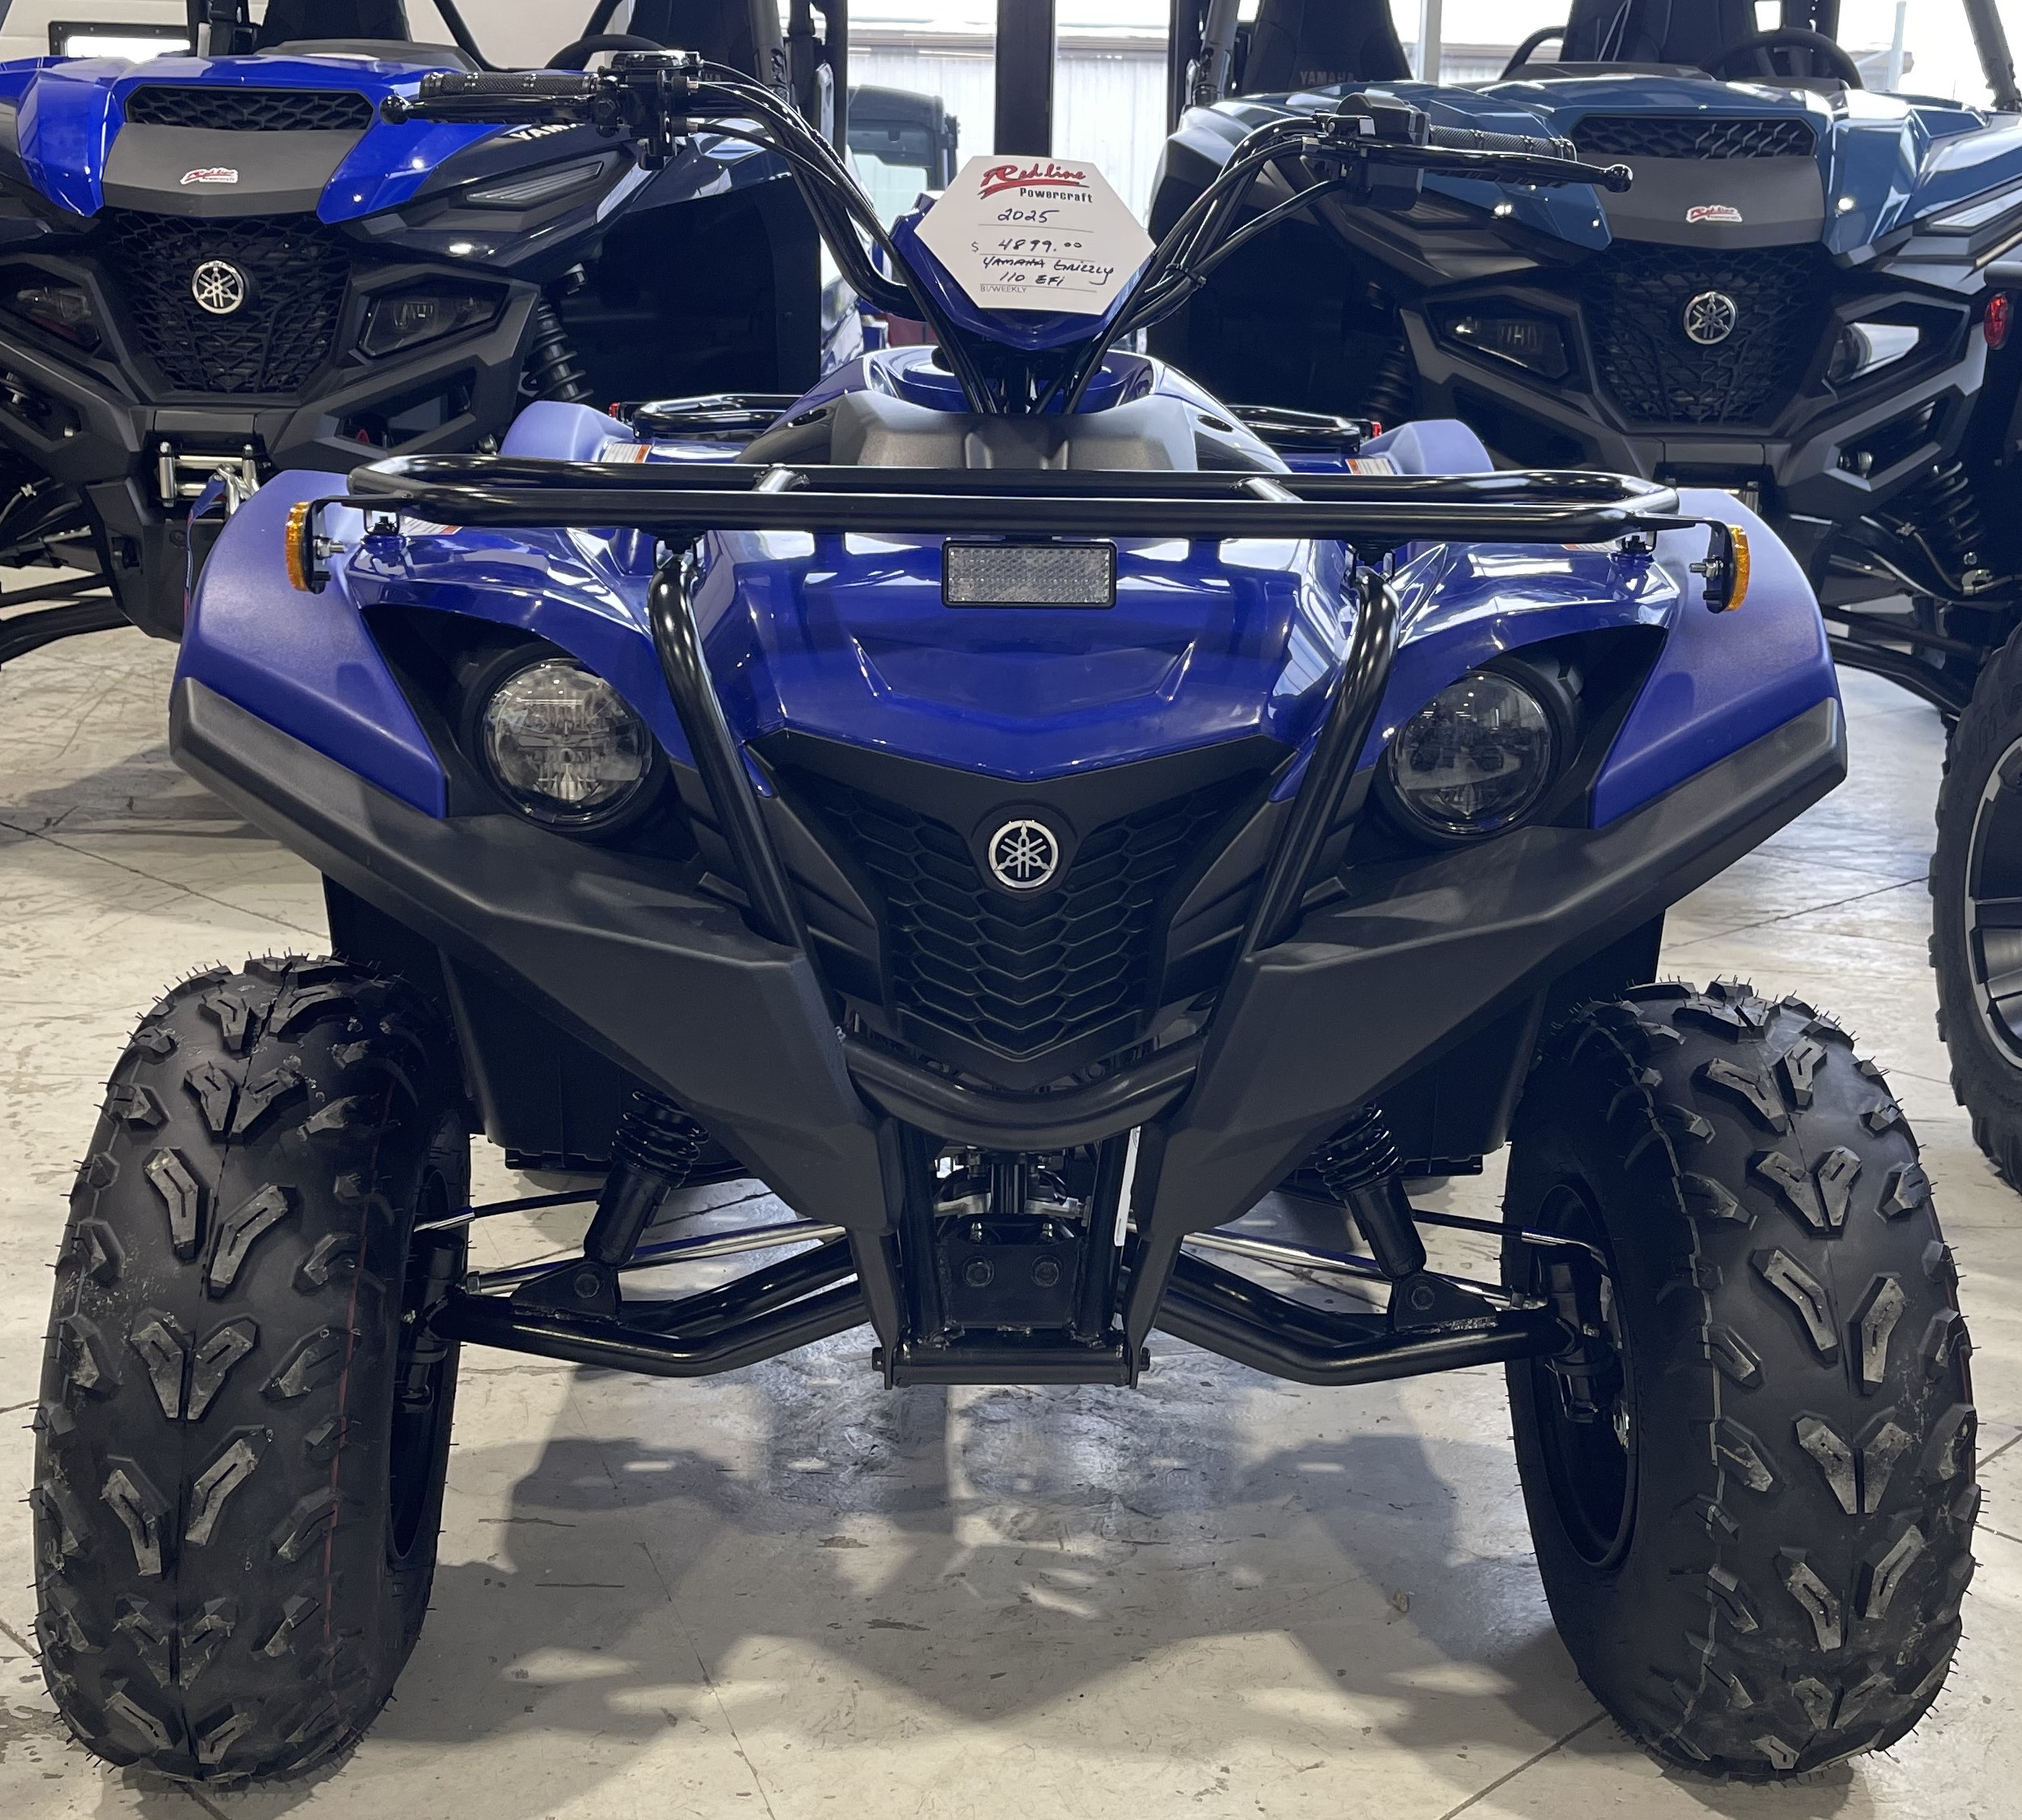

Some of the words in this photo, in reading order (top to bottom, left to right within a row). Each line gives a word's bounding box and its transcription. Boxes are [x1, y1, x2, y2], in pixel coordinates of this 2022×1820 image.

[1299, 70, 1354, 86] YAMAHA
[1019, 187, 1093, 203] Powercraft
[997, 208, 1060, 223] 2025
[971, 241, 979, 253] $
[998, 238, 1082, 253] 4899.00
[983, 256, 1045, 270] YAMAHA
[1000, 271, 1026, 283] 110
